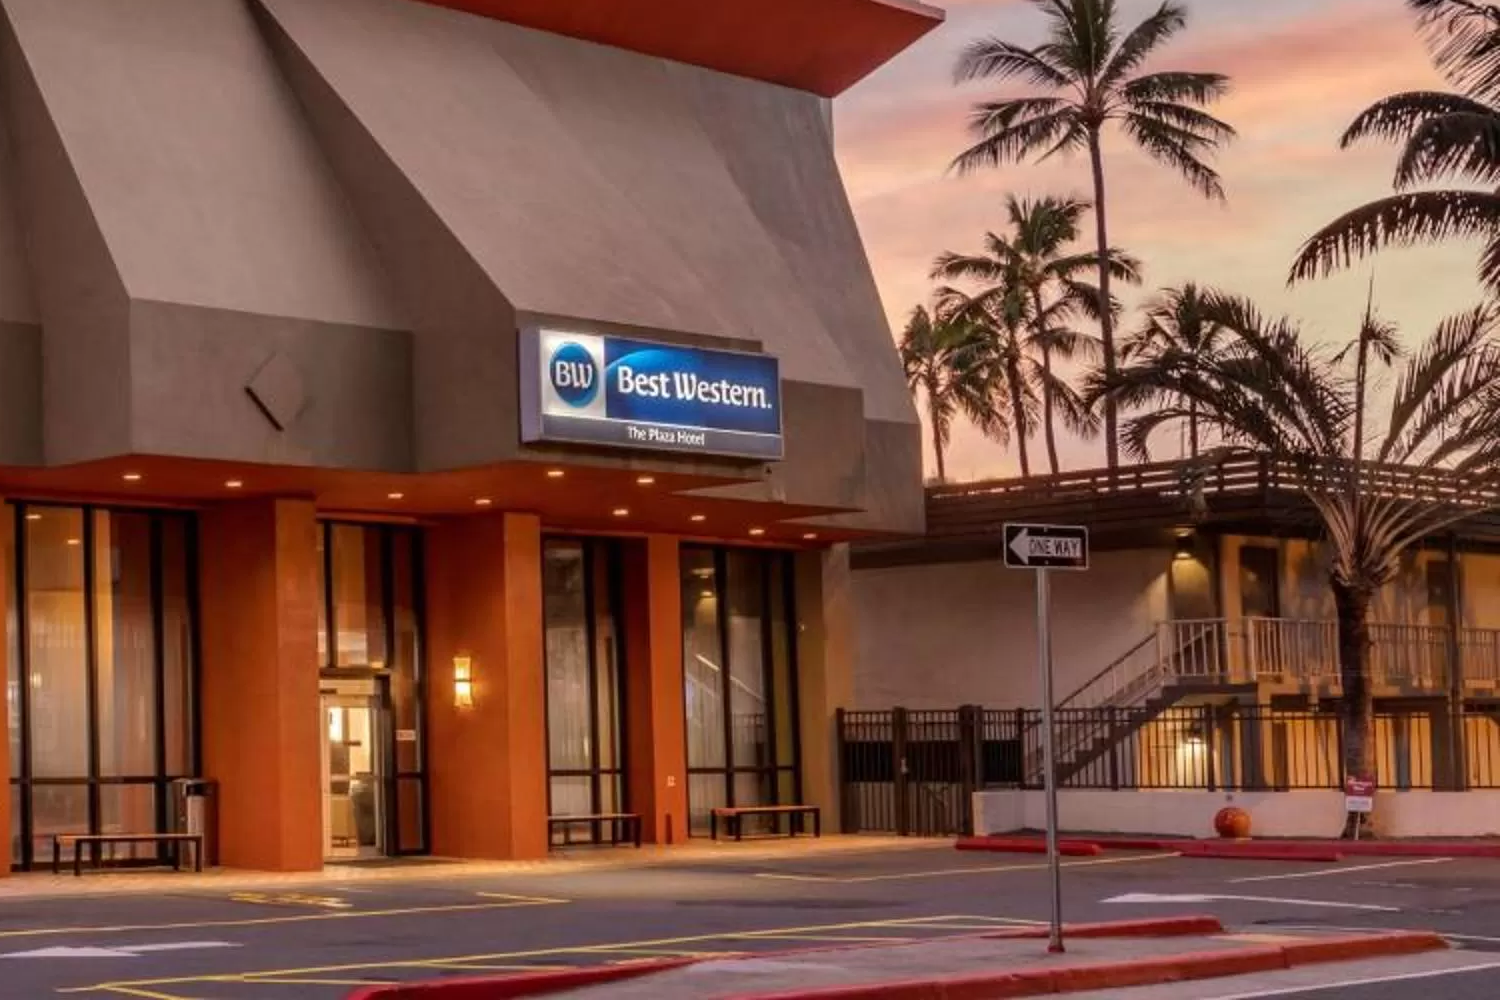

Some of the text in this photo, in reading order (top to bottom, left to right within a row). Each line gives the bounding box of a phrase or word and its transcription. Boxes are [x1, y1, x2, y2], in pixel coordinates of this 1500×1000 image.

[555, 360, 593, 389] BW
[618, 365, 669, 398] Best
[627, 425, 705, 446] The Plaza Hotel
[1029, 539, 1080, 556] ONE WAY
